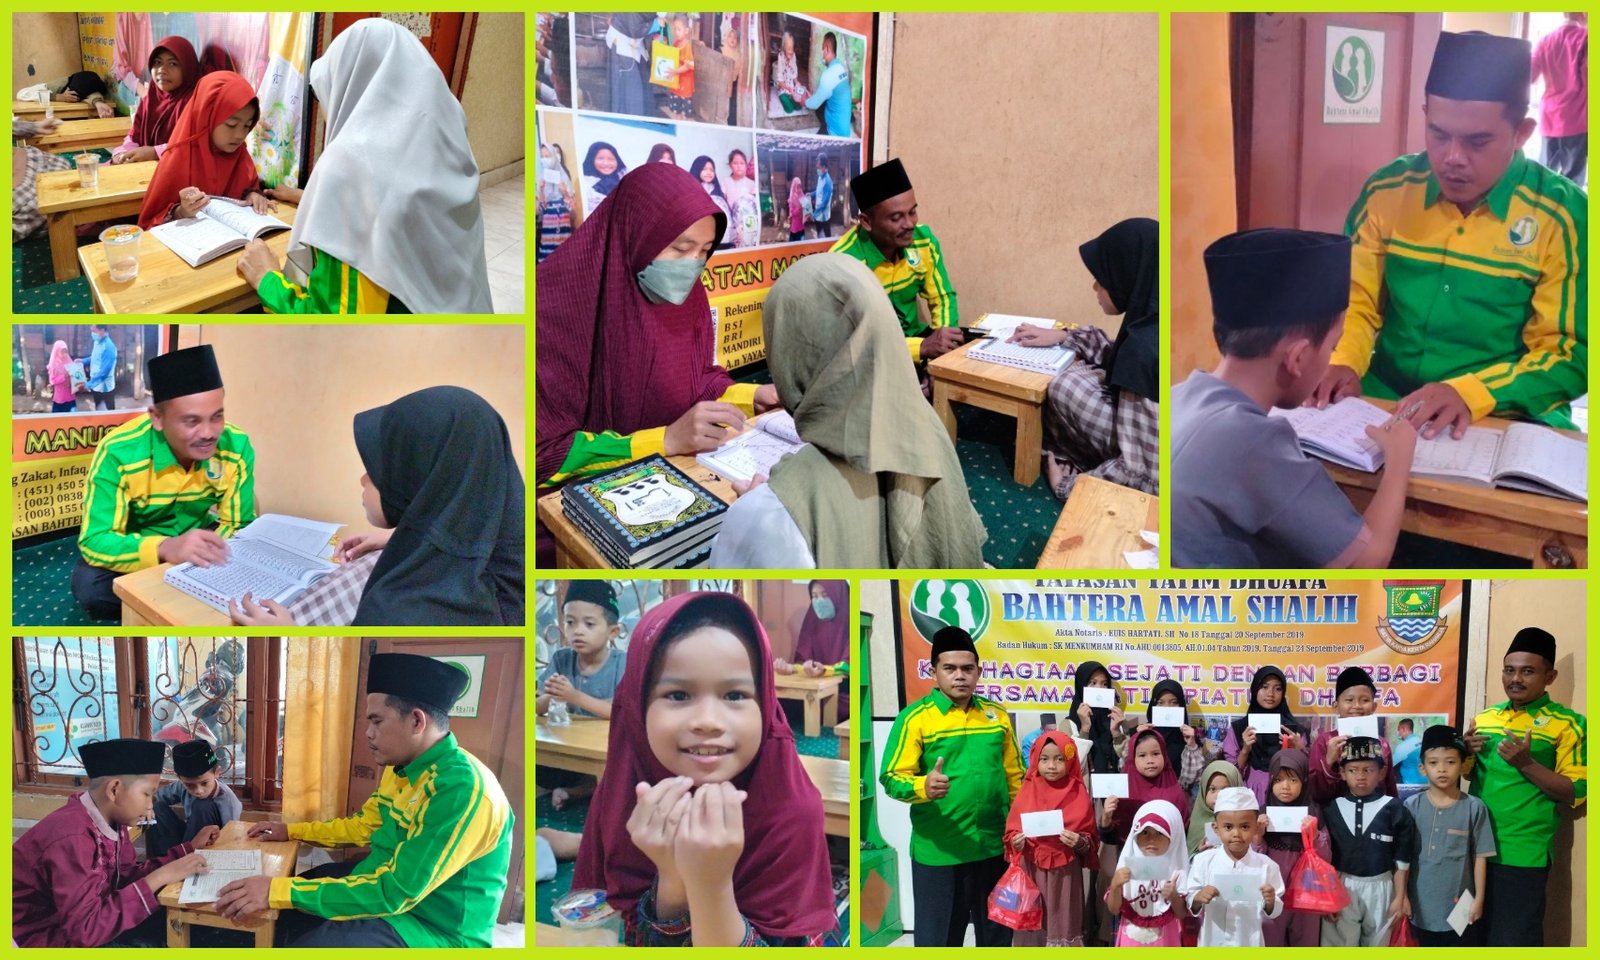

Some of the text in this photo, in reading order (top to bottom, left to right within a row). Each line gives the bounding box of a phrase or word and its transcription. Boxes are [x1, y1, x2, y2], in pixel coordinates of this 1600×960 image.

[725, 300, 764, 317] Rekenin
[722, 336, 761, 355] MANDIRI
[20, 469, 57, 483] Zakat,
[24, 484, 54, 499] (451)
[56, 481, 76, 492] 450
[24, 495, 54, 508] (002)
[25, 507, 55, 522] (008)
[59, 503, 78, 515] 155
[1002, 593, 1358, 624] BAHTERA AMAL SHALIH
[1055, 629, 1073, 637] Akta
[1075, 629, 1103, 637] Notaris
[1201, 631, 1232, 640] Tanggal
[1245, 631, 1285, 640] September
[997, 641, 1020, 649] Badan
[1022, 641, 1048, 649] Hukum
[1053, 642, 1063, 650] SK
[1065, 642, 1113, 650] MENKUMHAM
[1263, 645, 1294, 653] Tanggal
[1306, 645, 1345, 653] September
[1108, 664, 1201, 682] SEJATI
[1213, 665, 1315, 682] DENAN
[1326, 665, 1440, 682] BRBAGI
[974, 685, 1075, 702] ERSAMA
